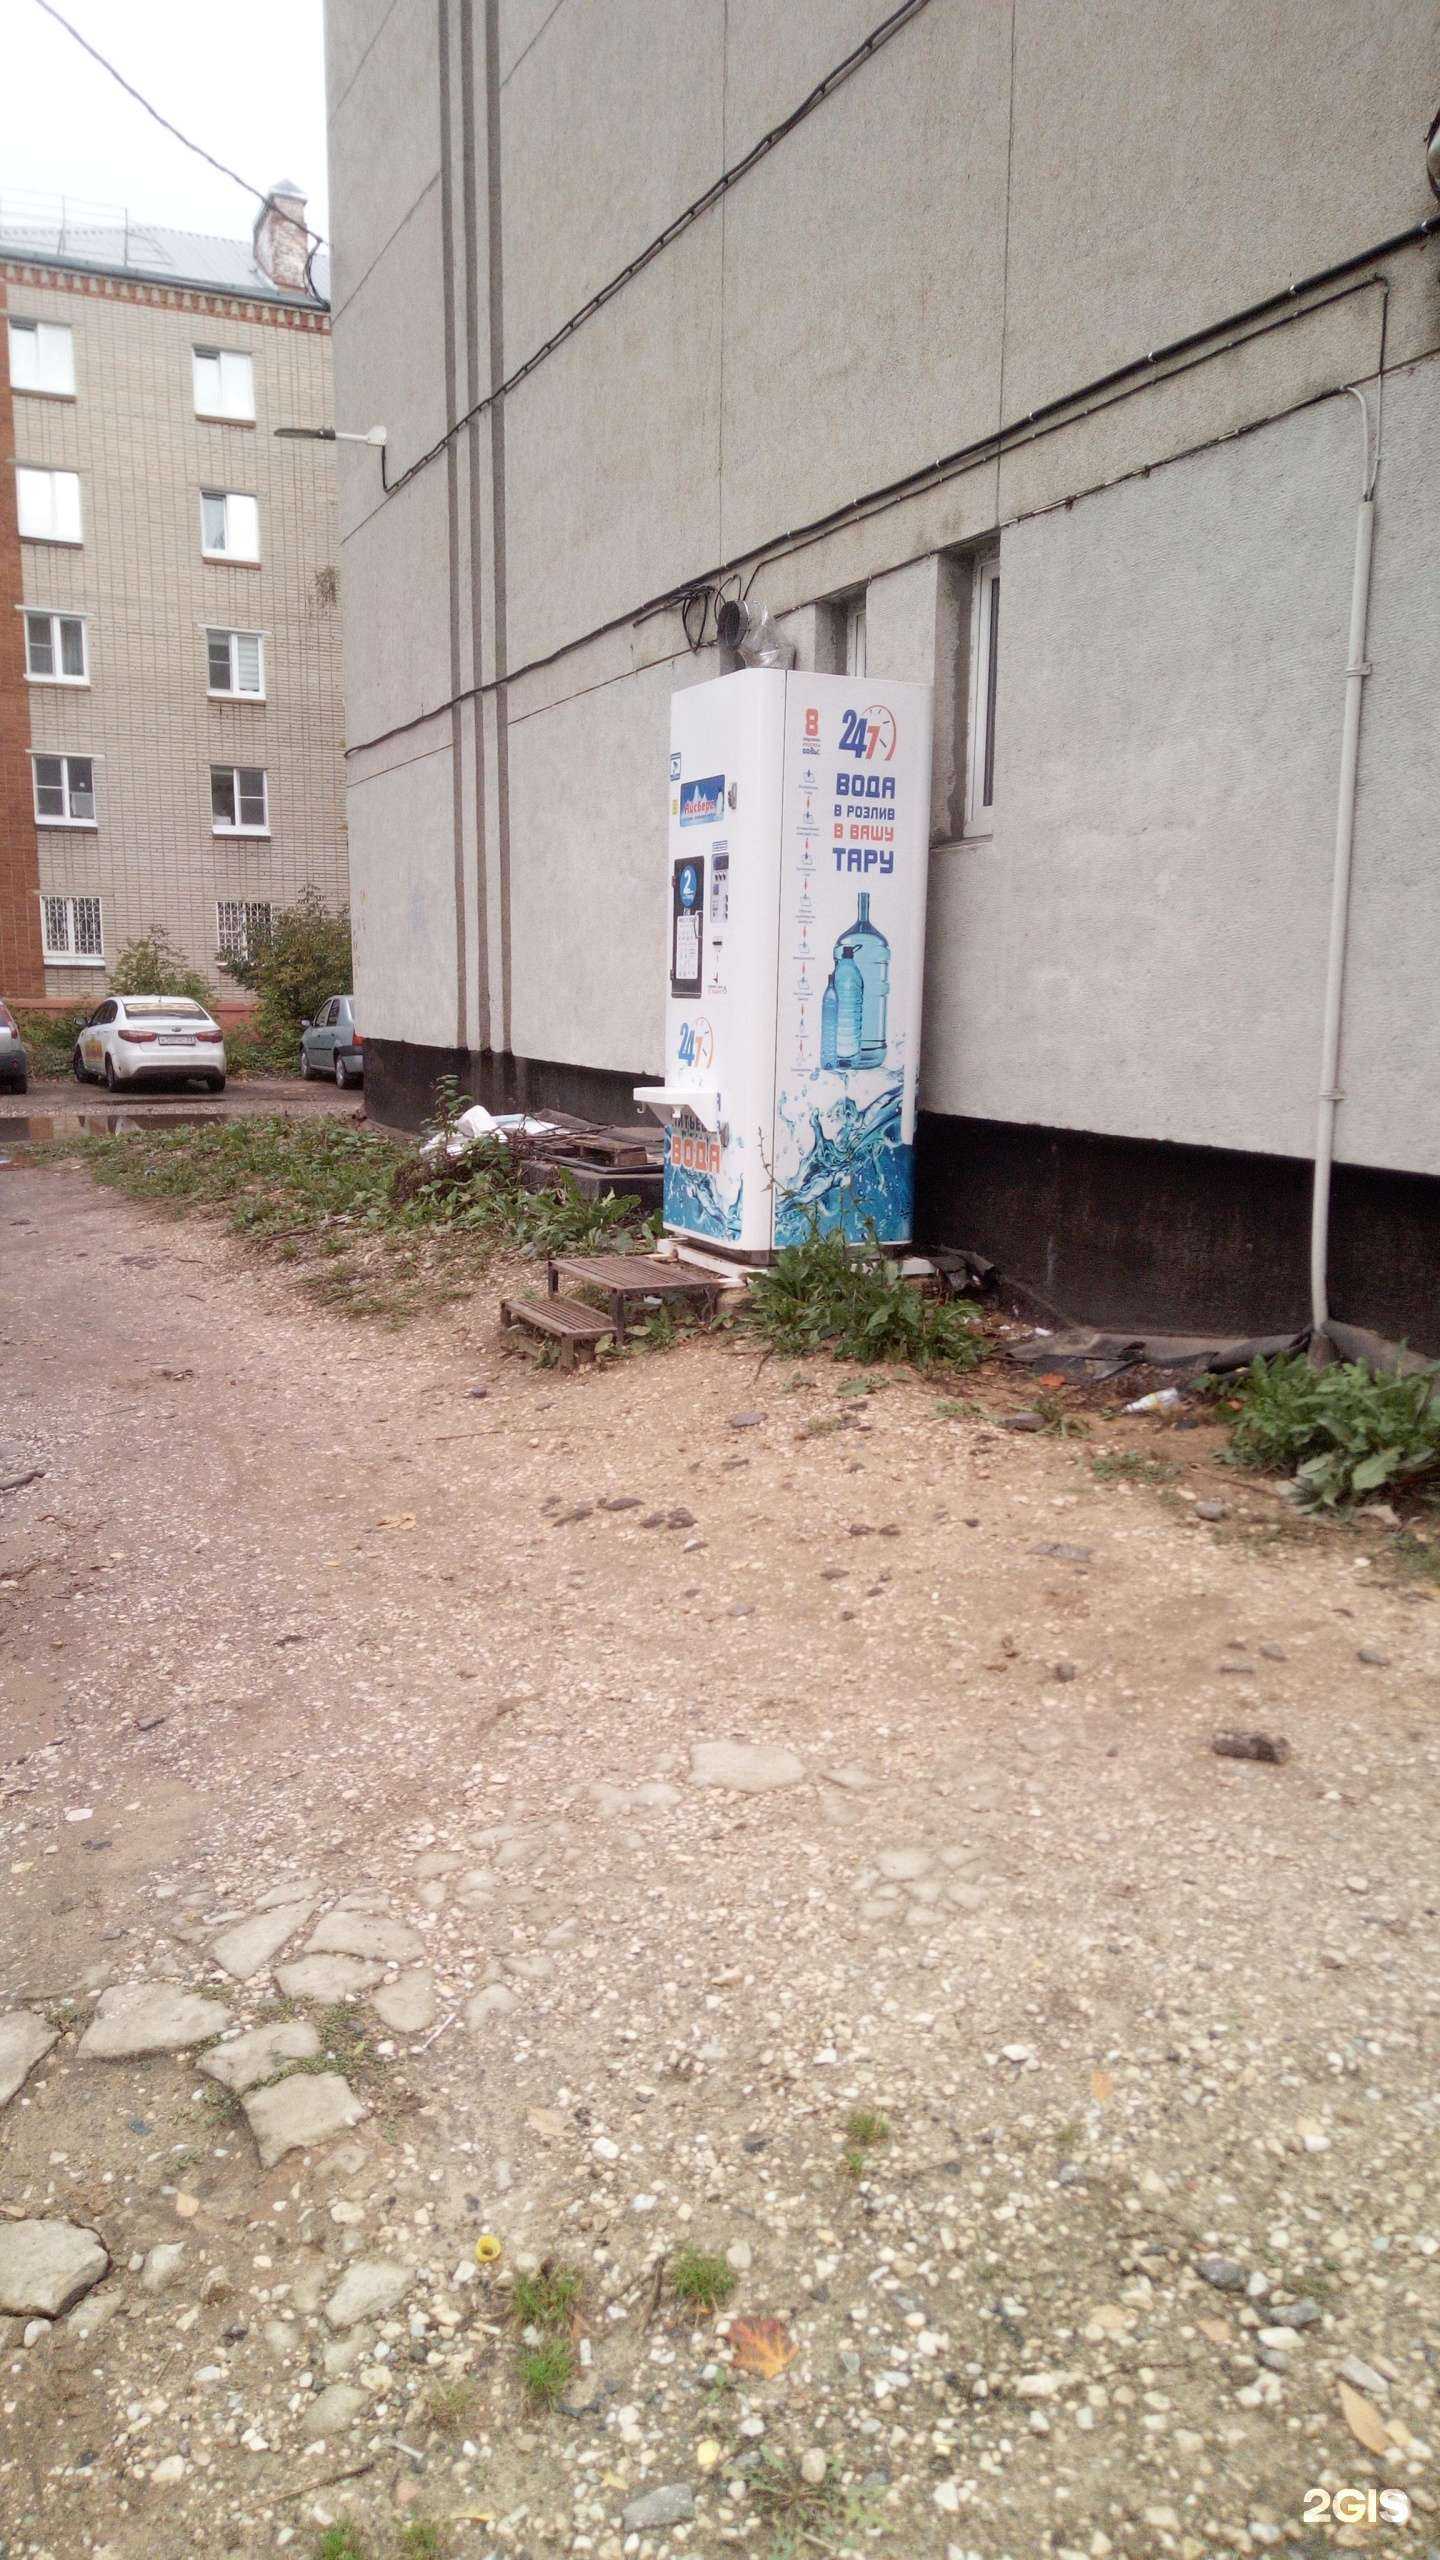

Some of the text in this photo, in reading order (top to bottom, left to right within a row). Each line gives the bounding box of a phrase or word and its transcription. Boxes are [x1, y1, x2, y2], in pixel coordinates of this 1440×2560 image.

[805, 708, 819, 737] 8
[836, 772, 896, 799] ВОДА
[834, 804, 895, 821] В РОЗЛИВ
[834, 822, 844, 839] В
[850, 823, 894, 842] ВАШУ
[832, 847, 894, 874] ТАРУ
[671, 1135, 720, 1173] ВОДА
